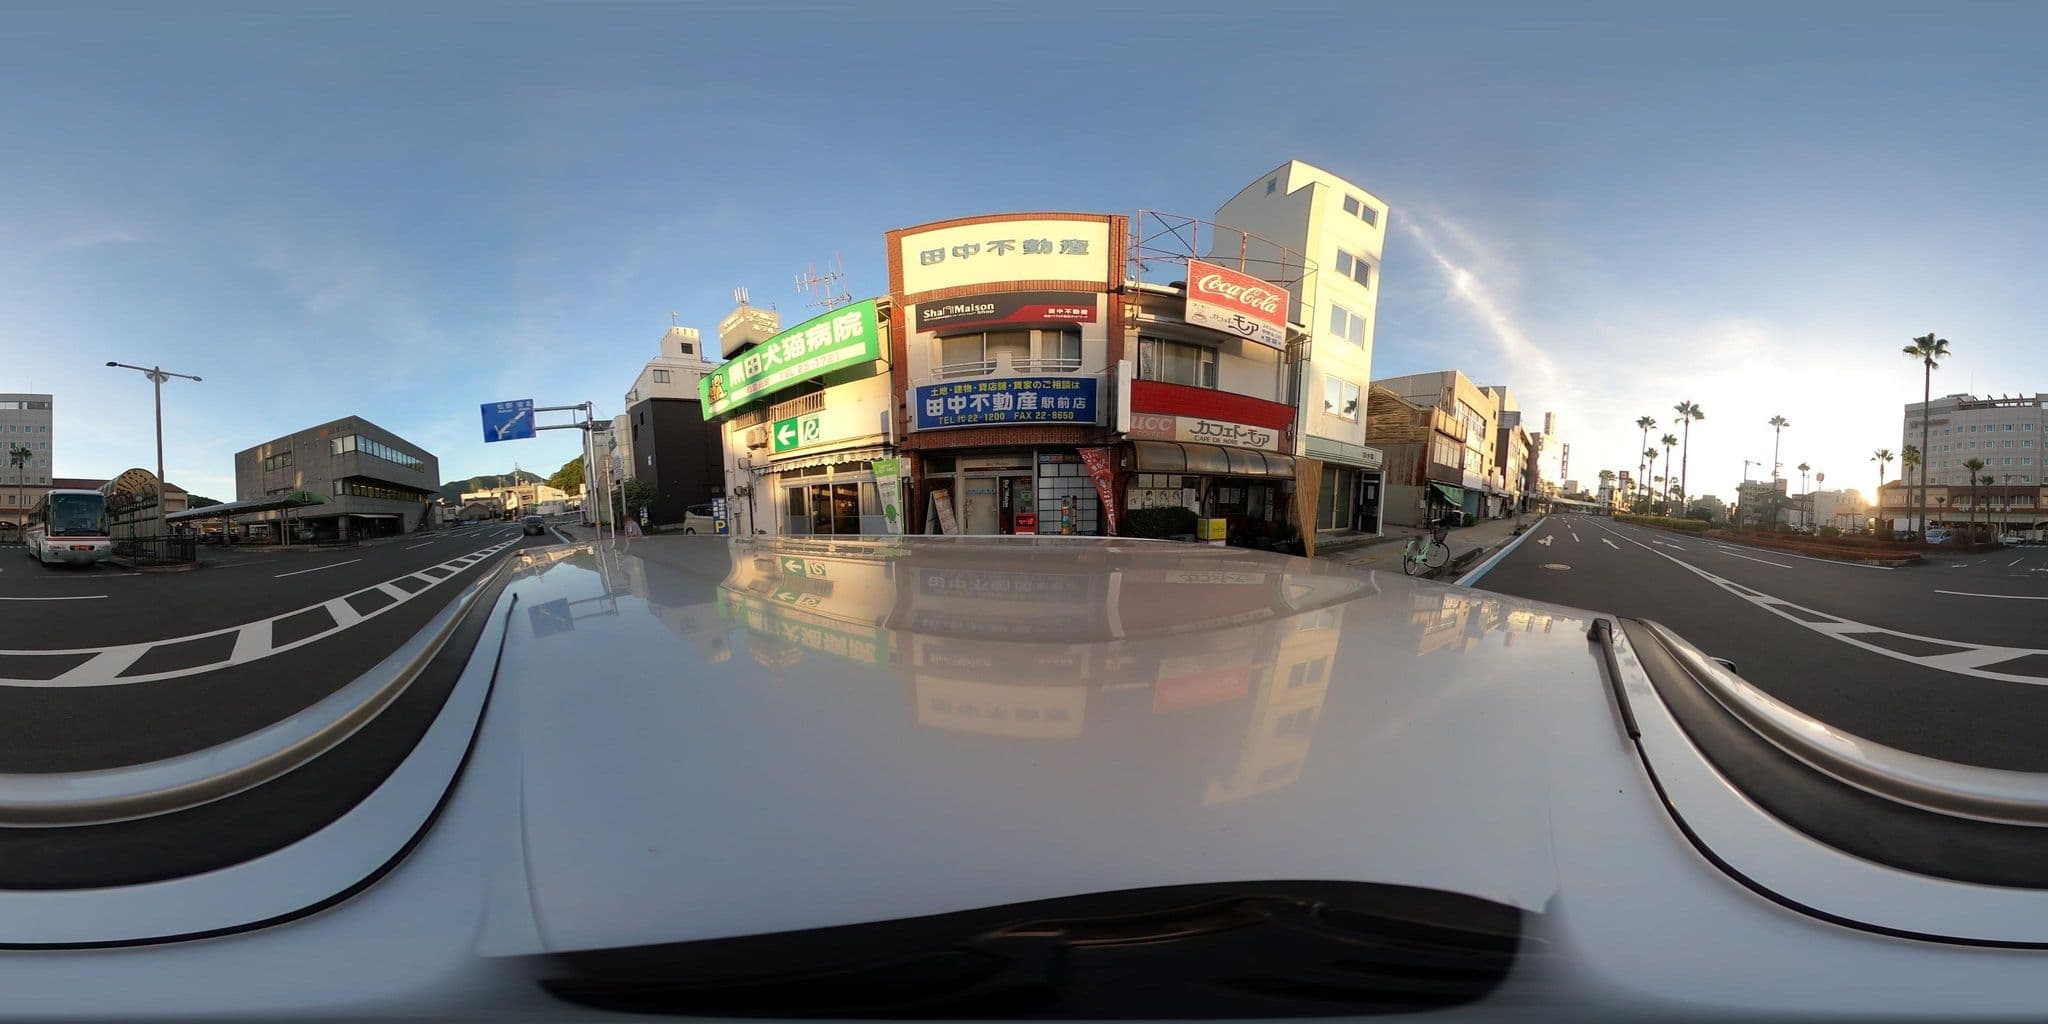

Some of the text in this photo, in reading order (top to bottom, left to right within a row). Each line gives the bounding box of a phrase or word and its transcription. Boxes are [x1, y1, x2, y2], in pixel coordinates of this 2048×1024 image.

[920, 238, 1089, 265] 田中不動産
[1197, 274, 1281, 313] Coca-Cola
[923, 309, 943, 318] Sha
[955, 303, 994, 313] Maison
[926, 391, 1086, 417] 田中不動産 駅前店
[938, 416, 954, 425] TEL
[1014, 411, 1031, 421] FAX
[715, 520, 726, 534] P
